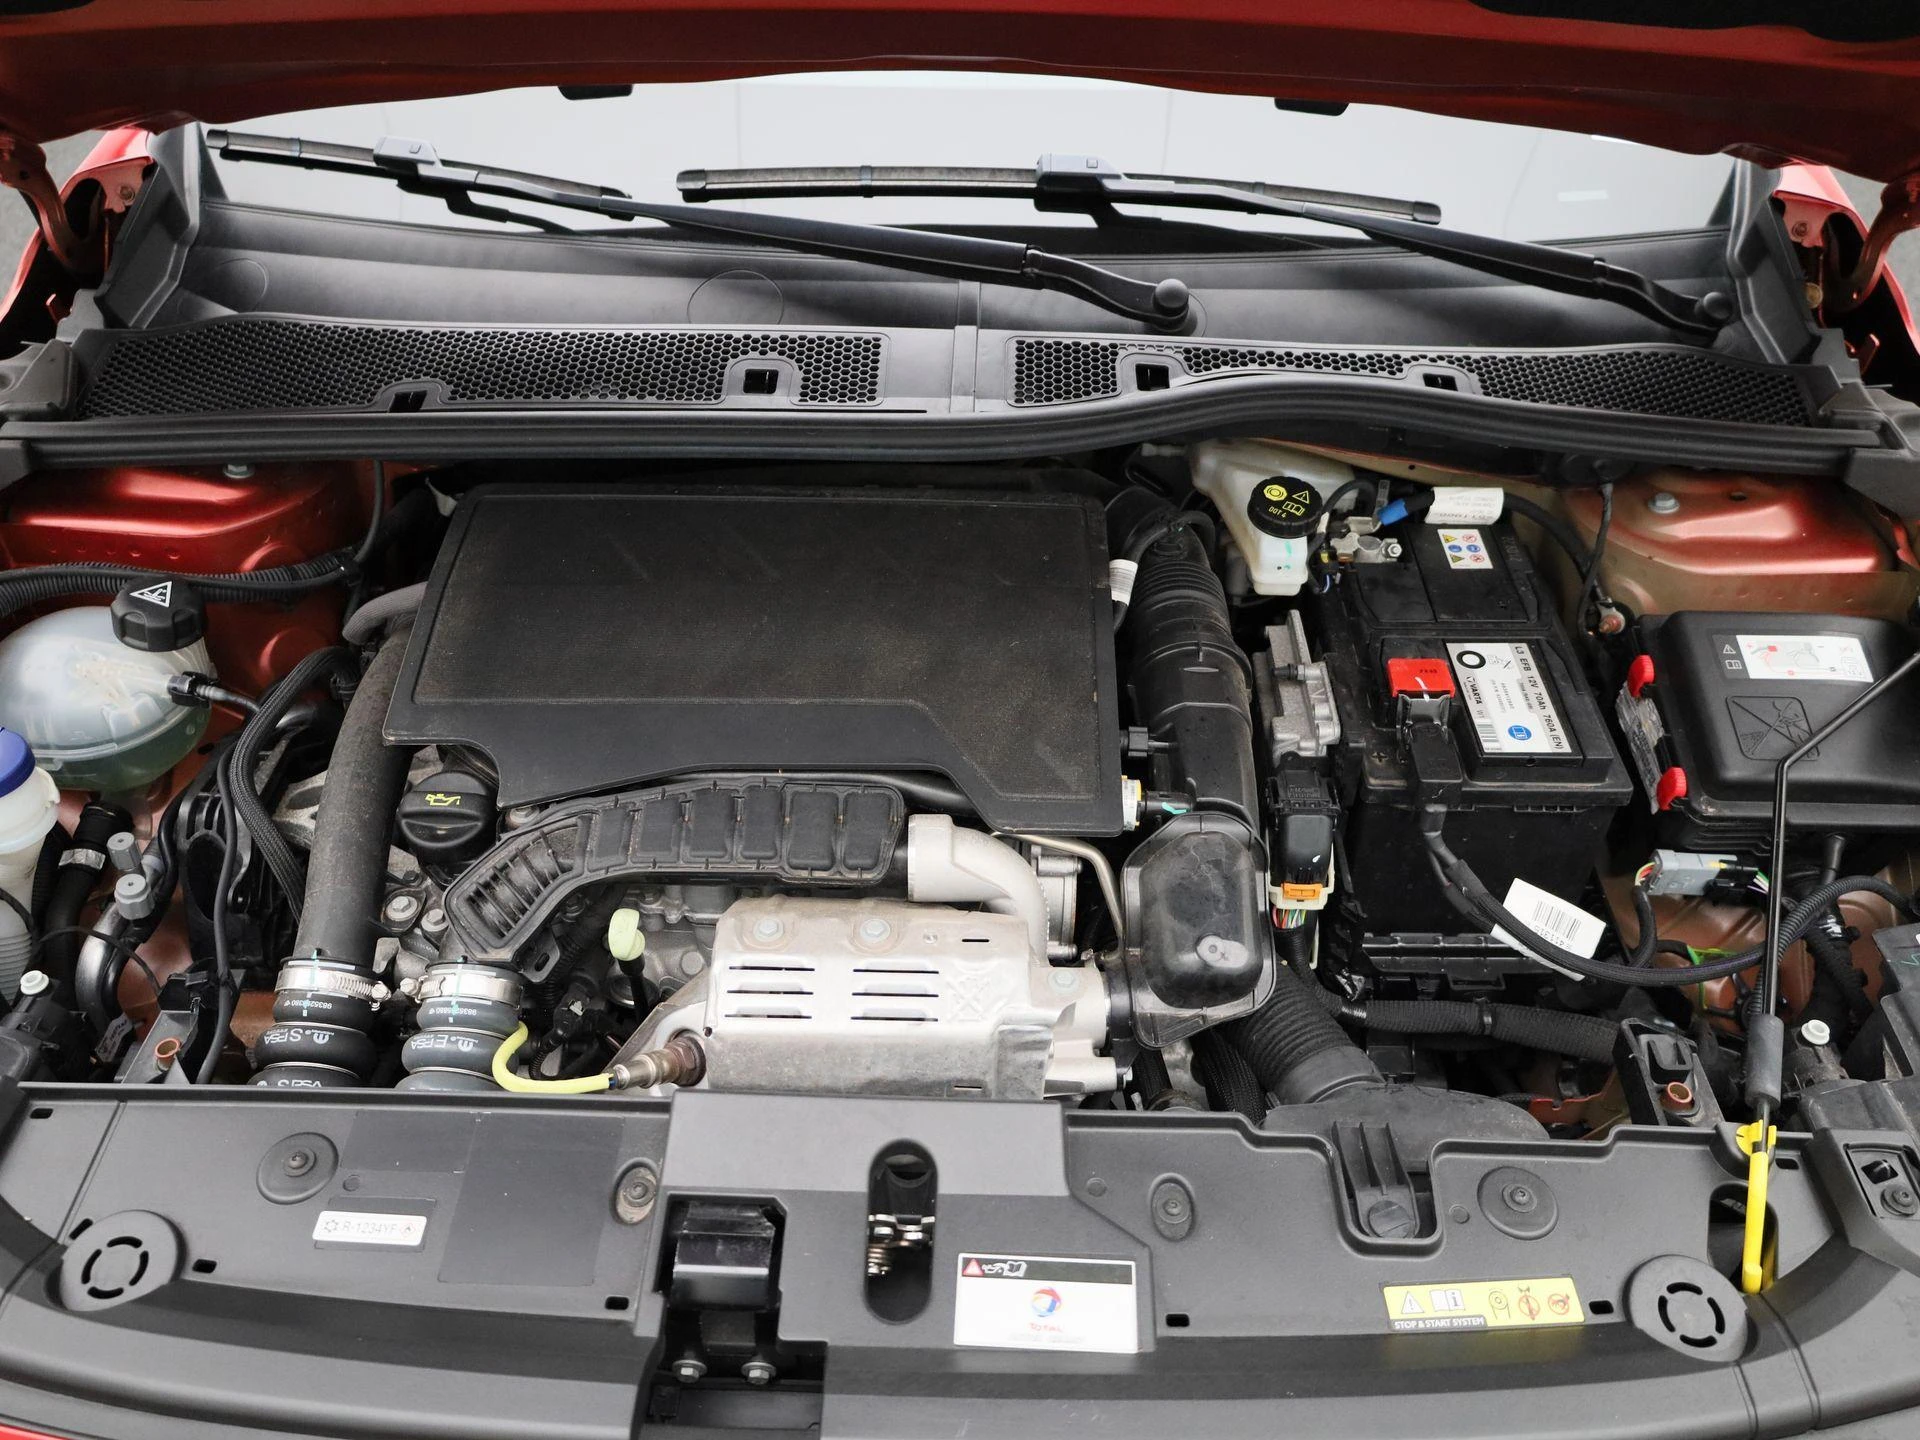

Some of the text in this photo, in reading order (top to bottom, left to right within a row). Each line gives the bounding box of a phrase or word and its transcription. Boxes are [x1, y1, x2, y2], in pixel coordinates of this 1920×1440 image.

[1471, 683, 1483, 705] VARTA
[1515, 646, 1525, 655] L3
[1520, 658, 1531, 672] EFB
[1527, 675, 1539, 688] 12V
[1534, 692, 1546, 711] 70Ah
[1543, 714, 1556, 733] 760A
[1394, 1316, 1484, 1329] STOP & START SYSTEM
